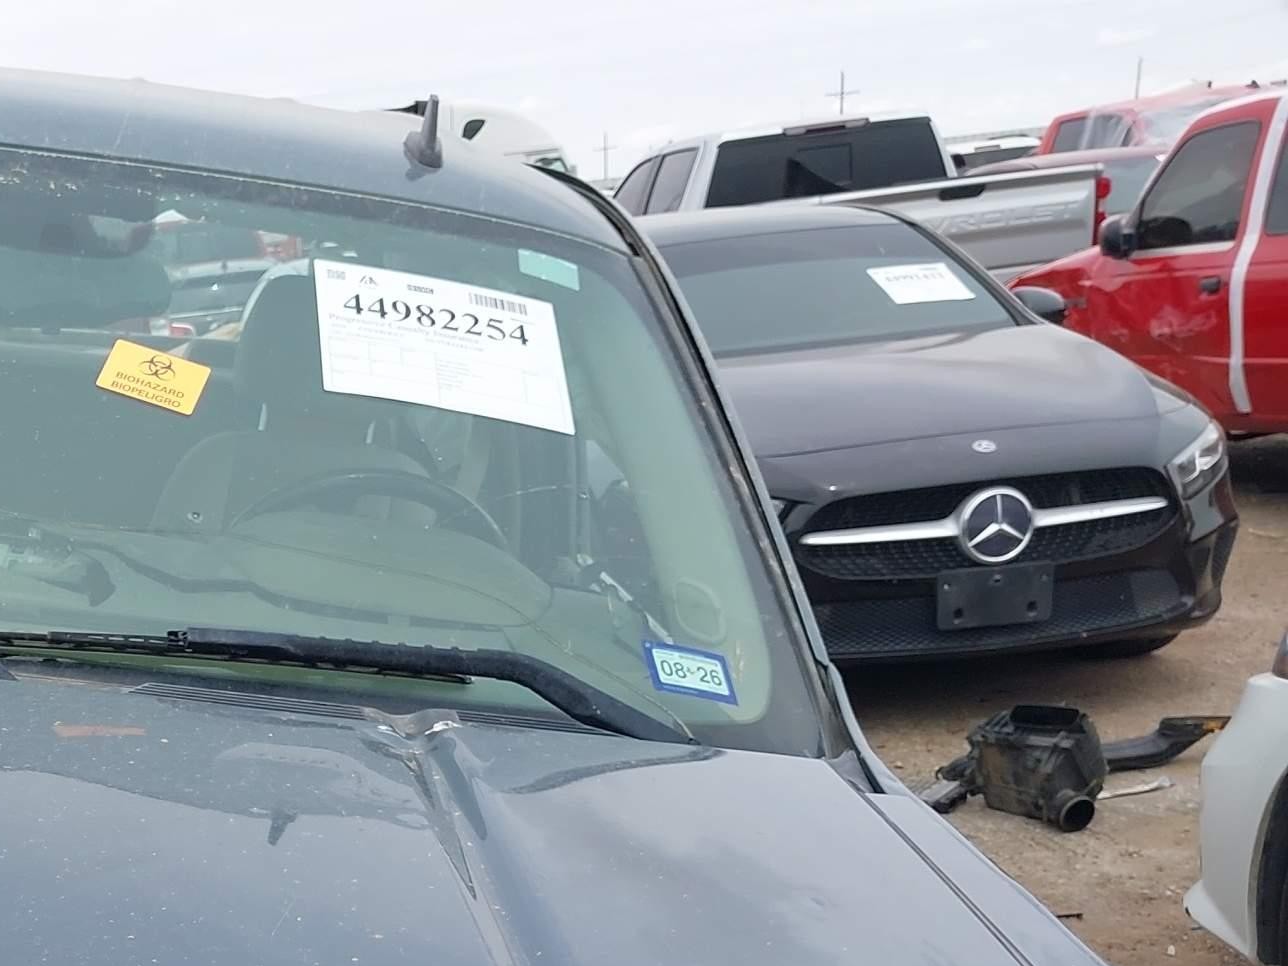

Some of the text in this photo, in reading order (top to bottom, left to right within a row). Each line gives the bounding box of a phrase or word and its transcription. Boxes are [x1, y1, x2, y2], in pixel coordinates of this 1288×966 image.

[925, 200, 1081, 233] VROLET
[343, 293, 529, 346] 44982254
[110, 380, 182, 408] BIOPELIGRO
[115, 371, 185, 399] BIOHAZARD
[660, 659, 722, 686] 08 26
